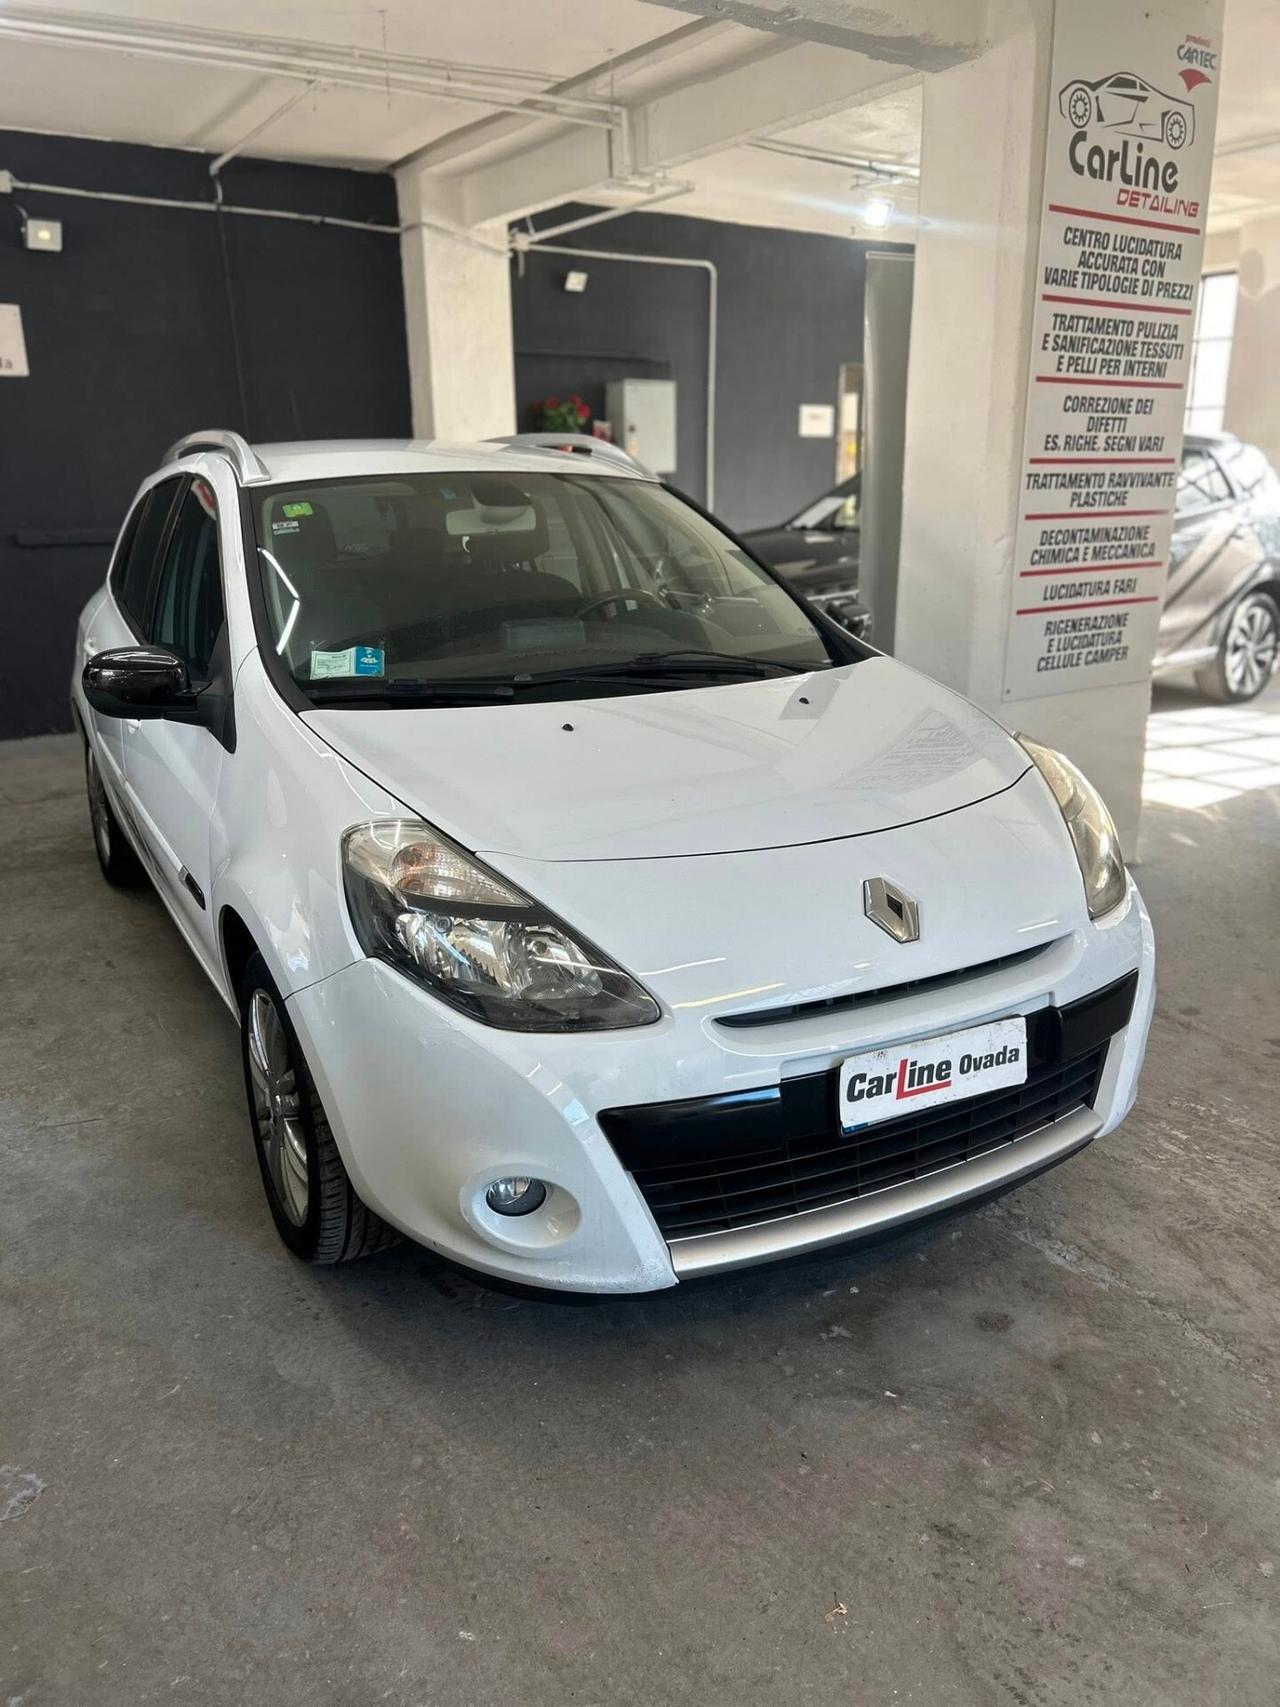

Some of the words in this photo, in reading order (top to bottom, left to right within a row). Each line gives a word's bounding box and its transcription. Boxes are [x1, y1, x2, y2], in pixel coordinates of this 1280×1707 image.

[1177, 44, 1217, 70] CARTEC
[1069, 130, 1178, 193] CarLine
[1117, 188, 1200, 218] DETAILING
[1063, 226, 1110, 251] CENTRO
[1112, 234, 1183, 260] LUCIDATURA
[1077, 250, 1139, 275] ACCURATA
[1141, 259, 1166, 278] CON
[1044, 266, 1079, 288] VARIE
[1080, 271, 1140, 295] TIPOLOGIE
[1141, 279, 1155, 297] DI
[1155, 281, 1194, 301] PREZZI
[1052, 313, 1134, 338] TRATTAMENTO
[1136, 321, 1179, 341] PULIZIA
[1041, 333, 1050, 351] E
[1051, 334, 1138, 357] SANIFICAZIONE
[1140, 341, 1184, 360] TESSUTI
[1056, 355, 1064, 372] E
[1066, 355, 1097, 374] PELLI
[1099, 358, 1122, 376] PER
[1123, 359, 1168, 378] INTERNI
[1063, 395, 1134, 415] CORREZIONE
[1135, 398, 1154, 415] DEI
[1086, 416, 1127, 433] DIFETTI
[1044, 434, 1061, 451] ES.
[1103, 435, 1137, 452] SEGNI
[1138, 436, 1165, 452] VARI
[1026, 472, 1105, 490] TRATTAMENTO
[1107, 472, 1175, 489] RAVVIVANTE
[1070, 491, 1129, 508] PLASTICHE
[1040, 525, 1151, 547] DECONTAMINAZIONE
[1030, 546, 1080, 566] CHIMICA
[1082, 546, 1089, 562] E
[1091, 542, 1156, 562] MECCANICA
[1043, 580, 1110, 601] LUCIDATURA
[1112, 578, 1138, 595] FARI
[1044, 613, 1130, 637] RIGENERAZIONE
[1047, 638, 1055, 653] E
[1056, 630, 1123, 653] LUCIDATURA
[1037, 651, 1083, 672] CELLULE
[1084, 646, 1129, 666] CAMPER
[846, 1058, 952, 1103] CarLine
[959, 1045, 1020, 1075] Ovada
